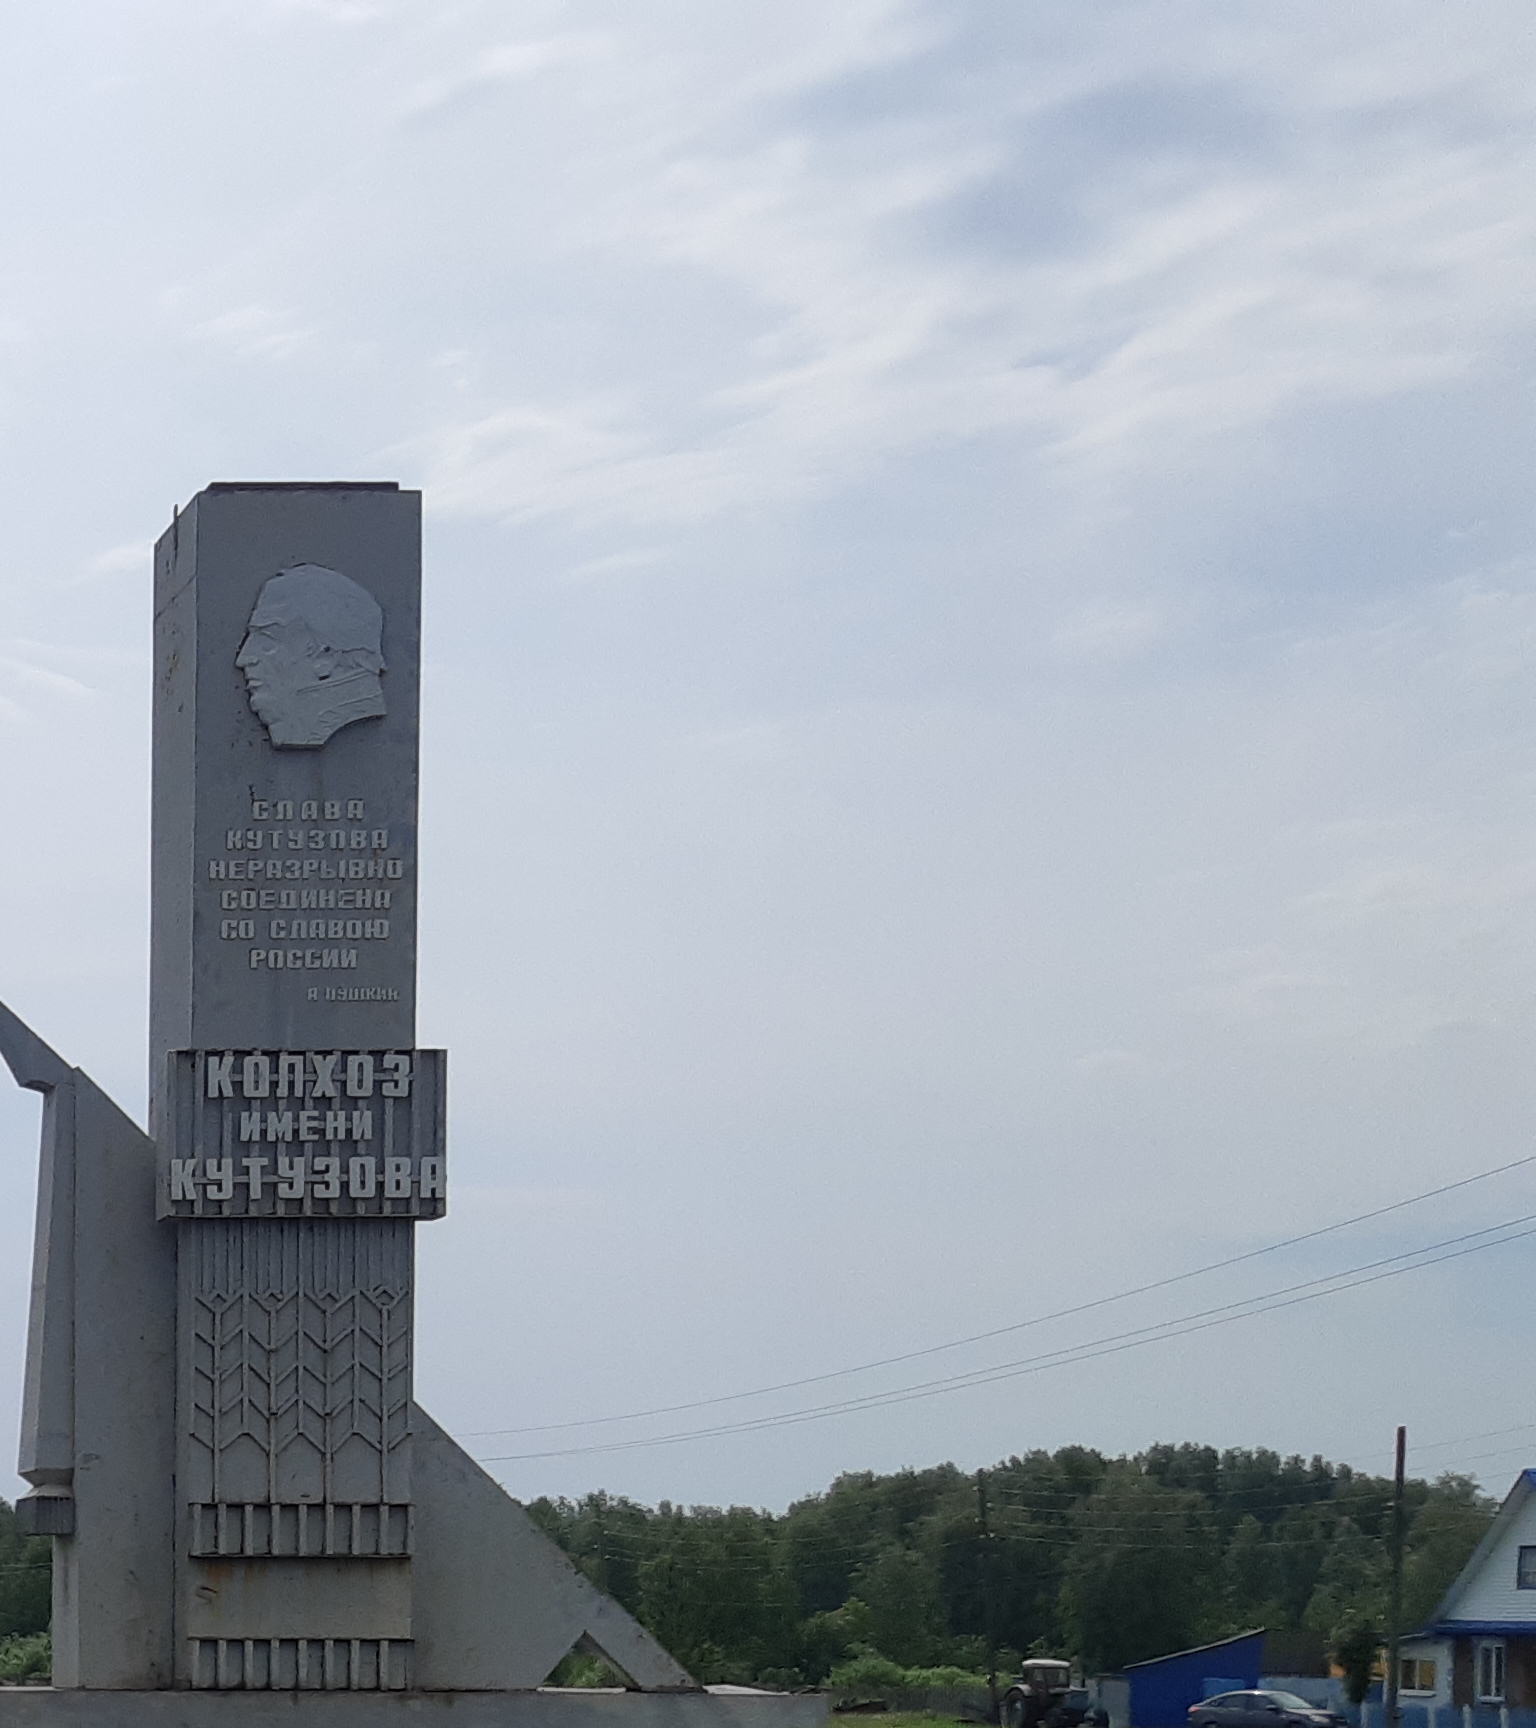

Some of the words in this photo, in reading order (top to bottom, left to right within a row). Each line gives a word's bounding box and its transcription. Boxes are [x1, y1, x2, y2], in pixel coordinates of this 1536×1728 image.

[251, 799, 365, 822] СЛАВА
[226, 829, 389, 850] КУТУЗОВА
[208, 858, 404, 881] НЕРАЗРЫВНО
[220, 889, 392, 911] СОЕДИНЕНА
[220, 918, 256, 940] СО
[268, 918, 390, 940] СЛАВОЮ
[249, 948, 358, 970] РОССИИ
[207, 1054, 411, 1099] КОЛХОЗ
[240, 1110, 373, 1142] ИМЕНИ
[170, 1155, 446, 1201] КУТУЗОВА
